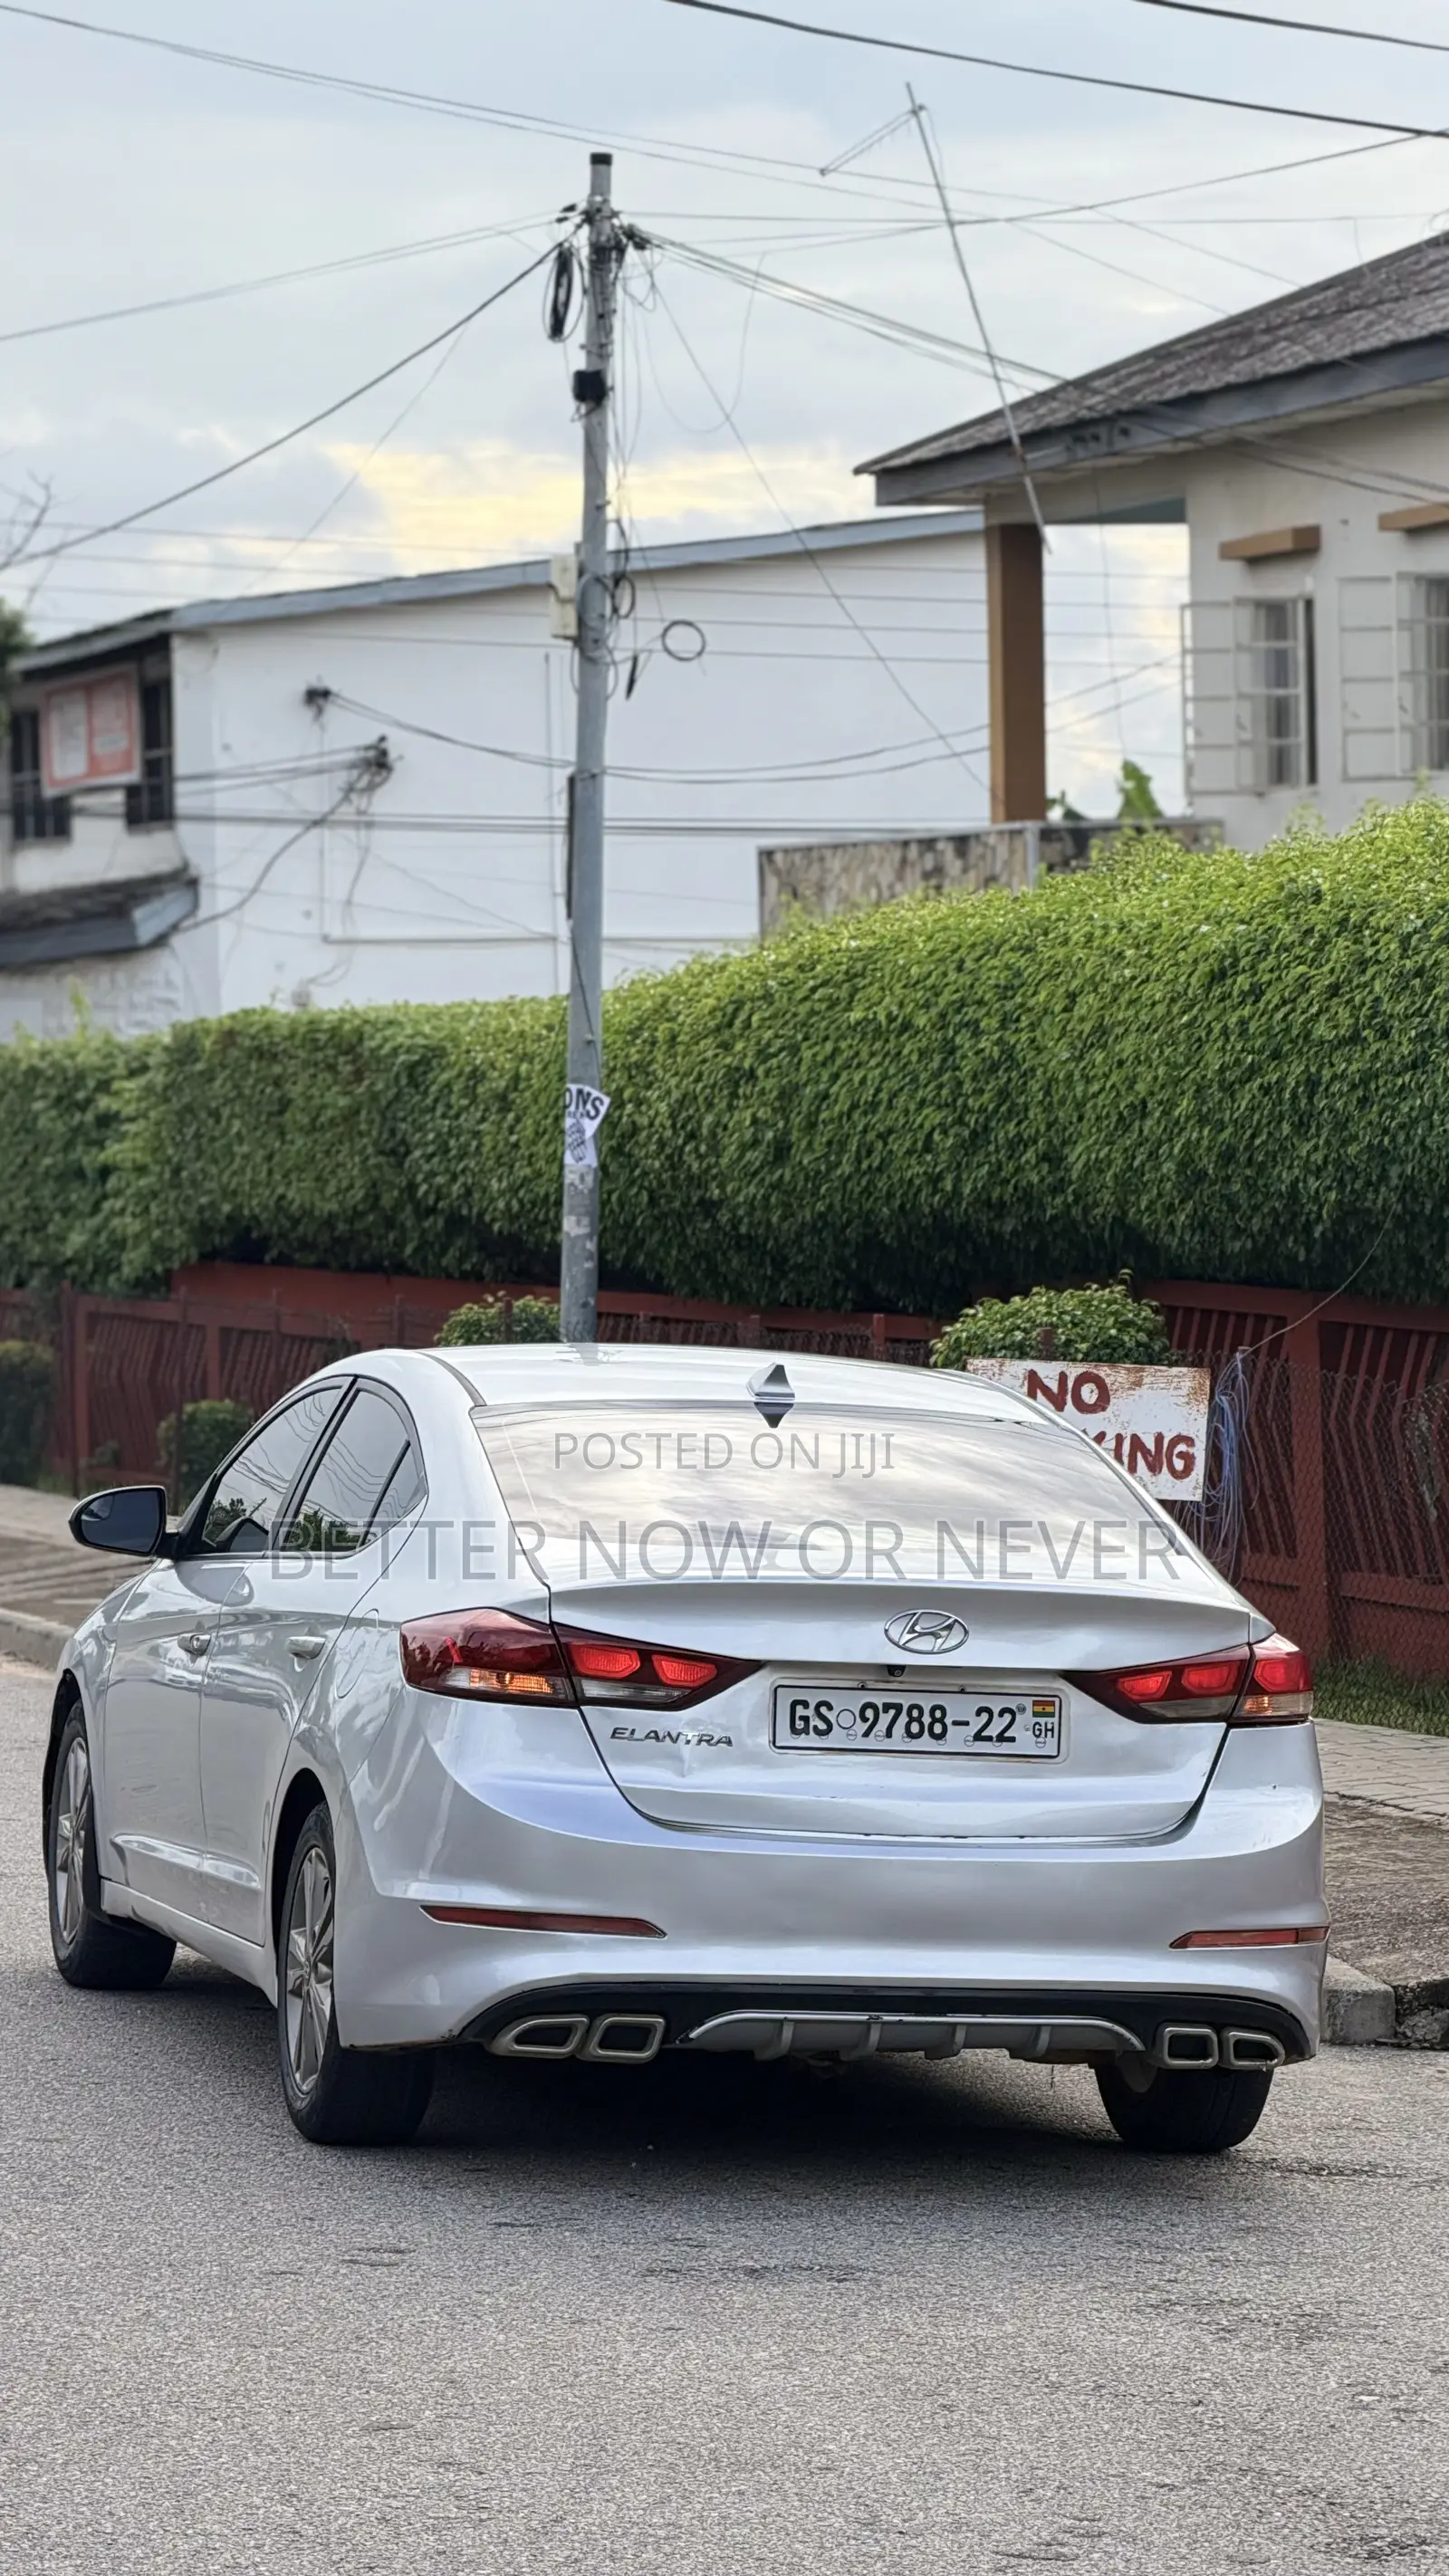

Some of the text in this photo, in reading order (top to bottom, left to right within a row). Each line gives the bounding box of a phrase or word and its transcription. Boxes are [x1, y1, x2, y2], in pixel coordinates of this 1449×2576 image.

[1027, 1369, 1110, 1414] NO
[609, 1727, 734, 1748] ELANTRA
[789, 1699, 1017, 1744] GS 9788-22
[1032, 1721, 1055, 1739] GH
